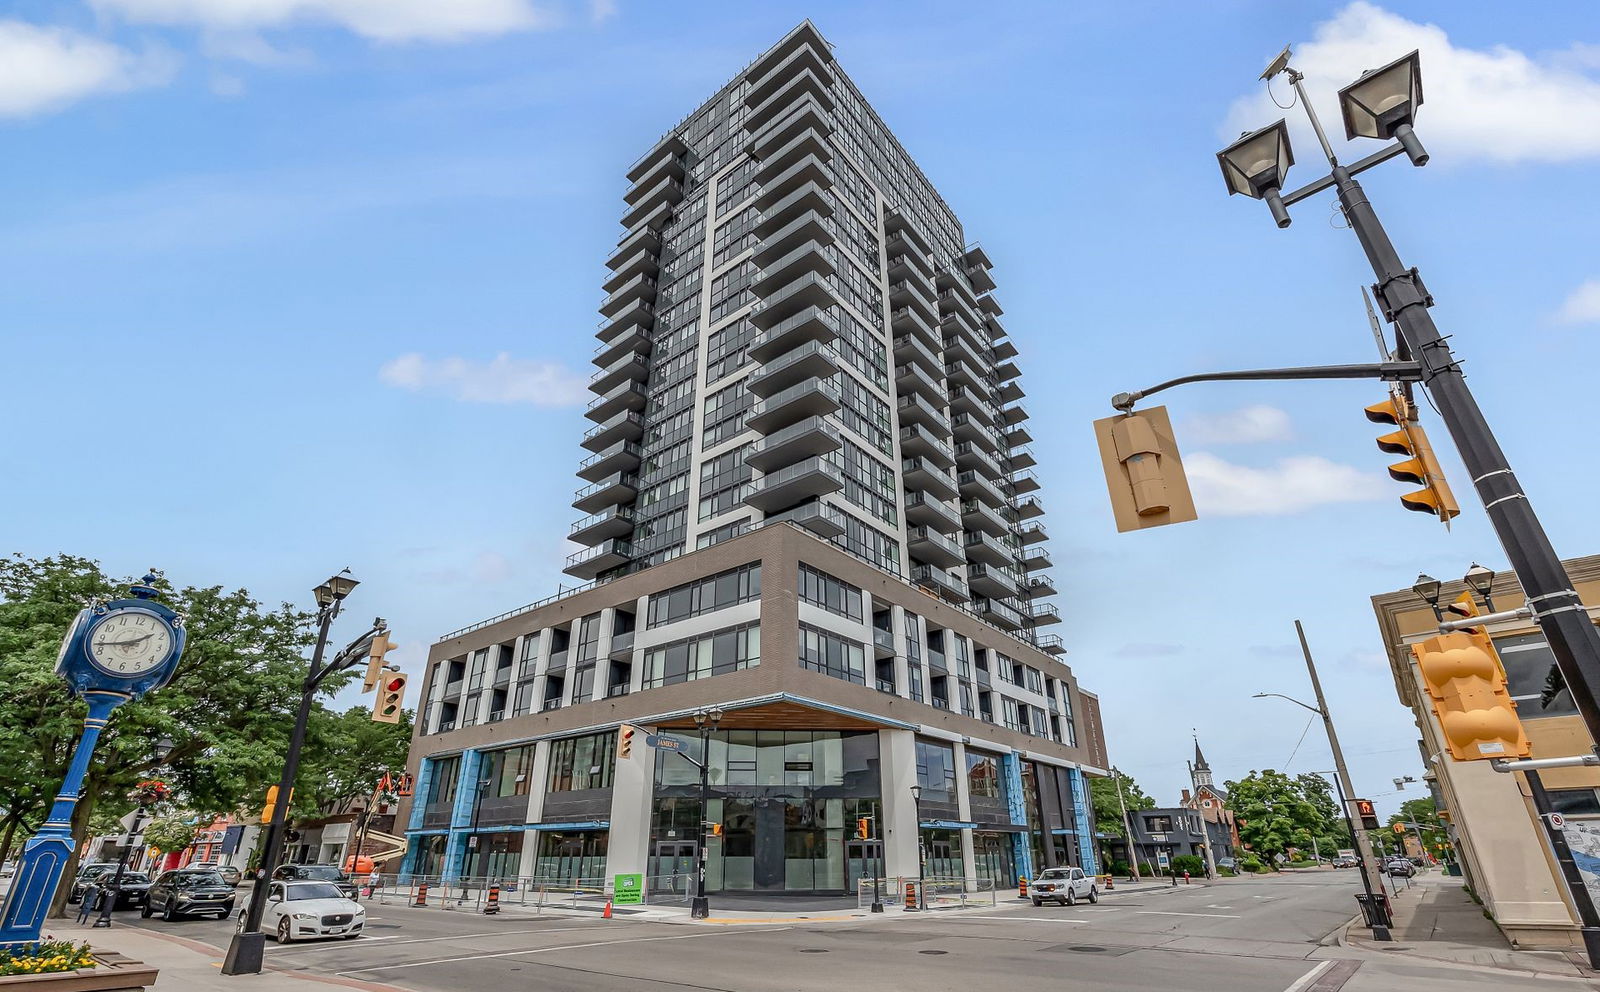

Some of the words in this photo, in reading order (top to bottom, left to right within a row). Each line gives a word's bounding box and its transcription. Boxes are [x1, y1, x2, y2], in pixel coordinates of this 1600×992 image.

[120, 617, 128, 626] 11
[136, 617, 146, 626] 12
[105, 624, 115, 632] 10
[151, 622, 155, 630] 1
[158, 632, 165, 640] 2
[96, 647, 104, 655] 8
[107, 658, 114, 666] 7
[148, 655, 155, 664] 4
[119, 662, 126, 671] 6
[134, 662, 141, 670] 5
[657, 739, 673, 748] JAMES
